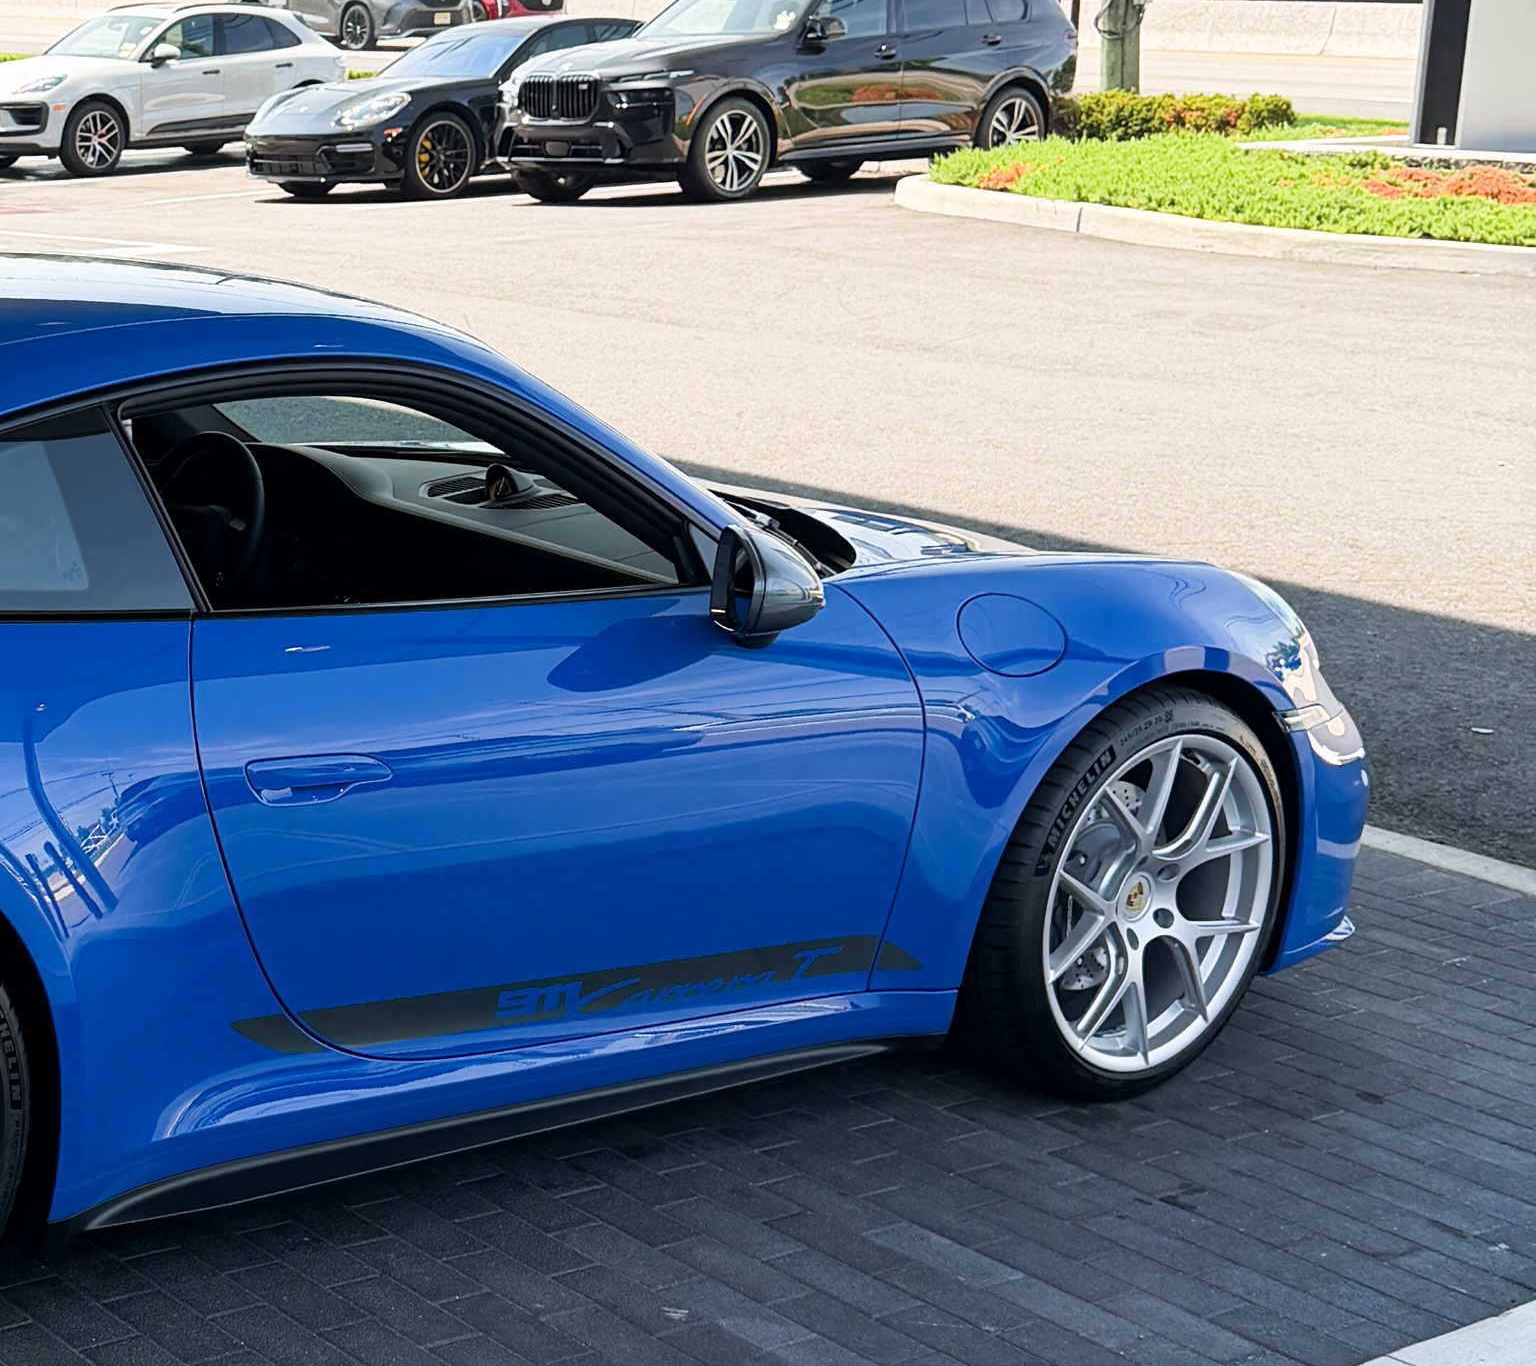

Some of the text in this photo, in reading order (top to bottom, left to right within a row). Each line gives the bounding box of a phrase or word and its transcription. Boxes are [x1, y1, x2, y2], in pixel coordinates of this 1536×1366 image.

[1048, 749, 1114, 848] MICHELIN
[495, 981, 583, 1021] 911
[790, 946, 845, 983] T
